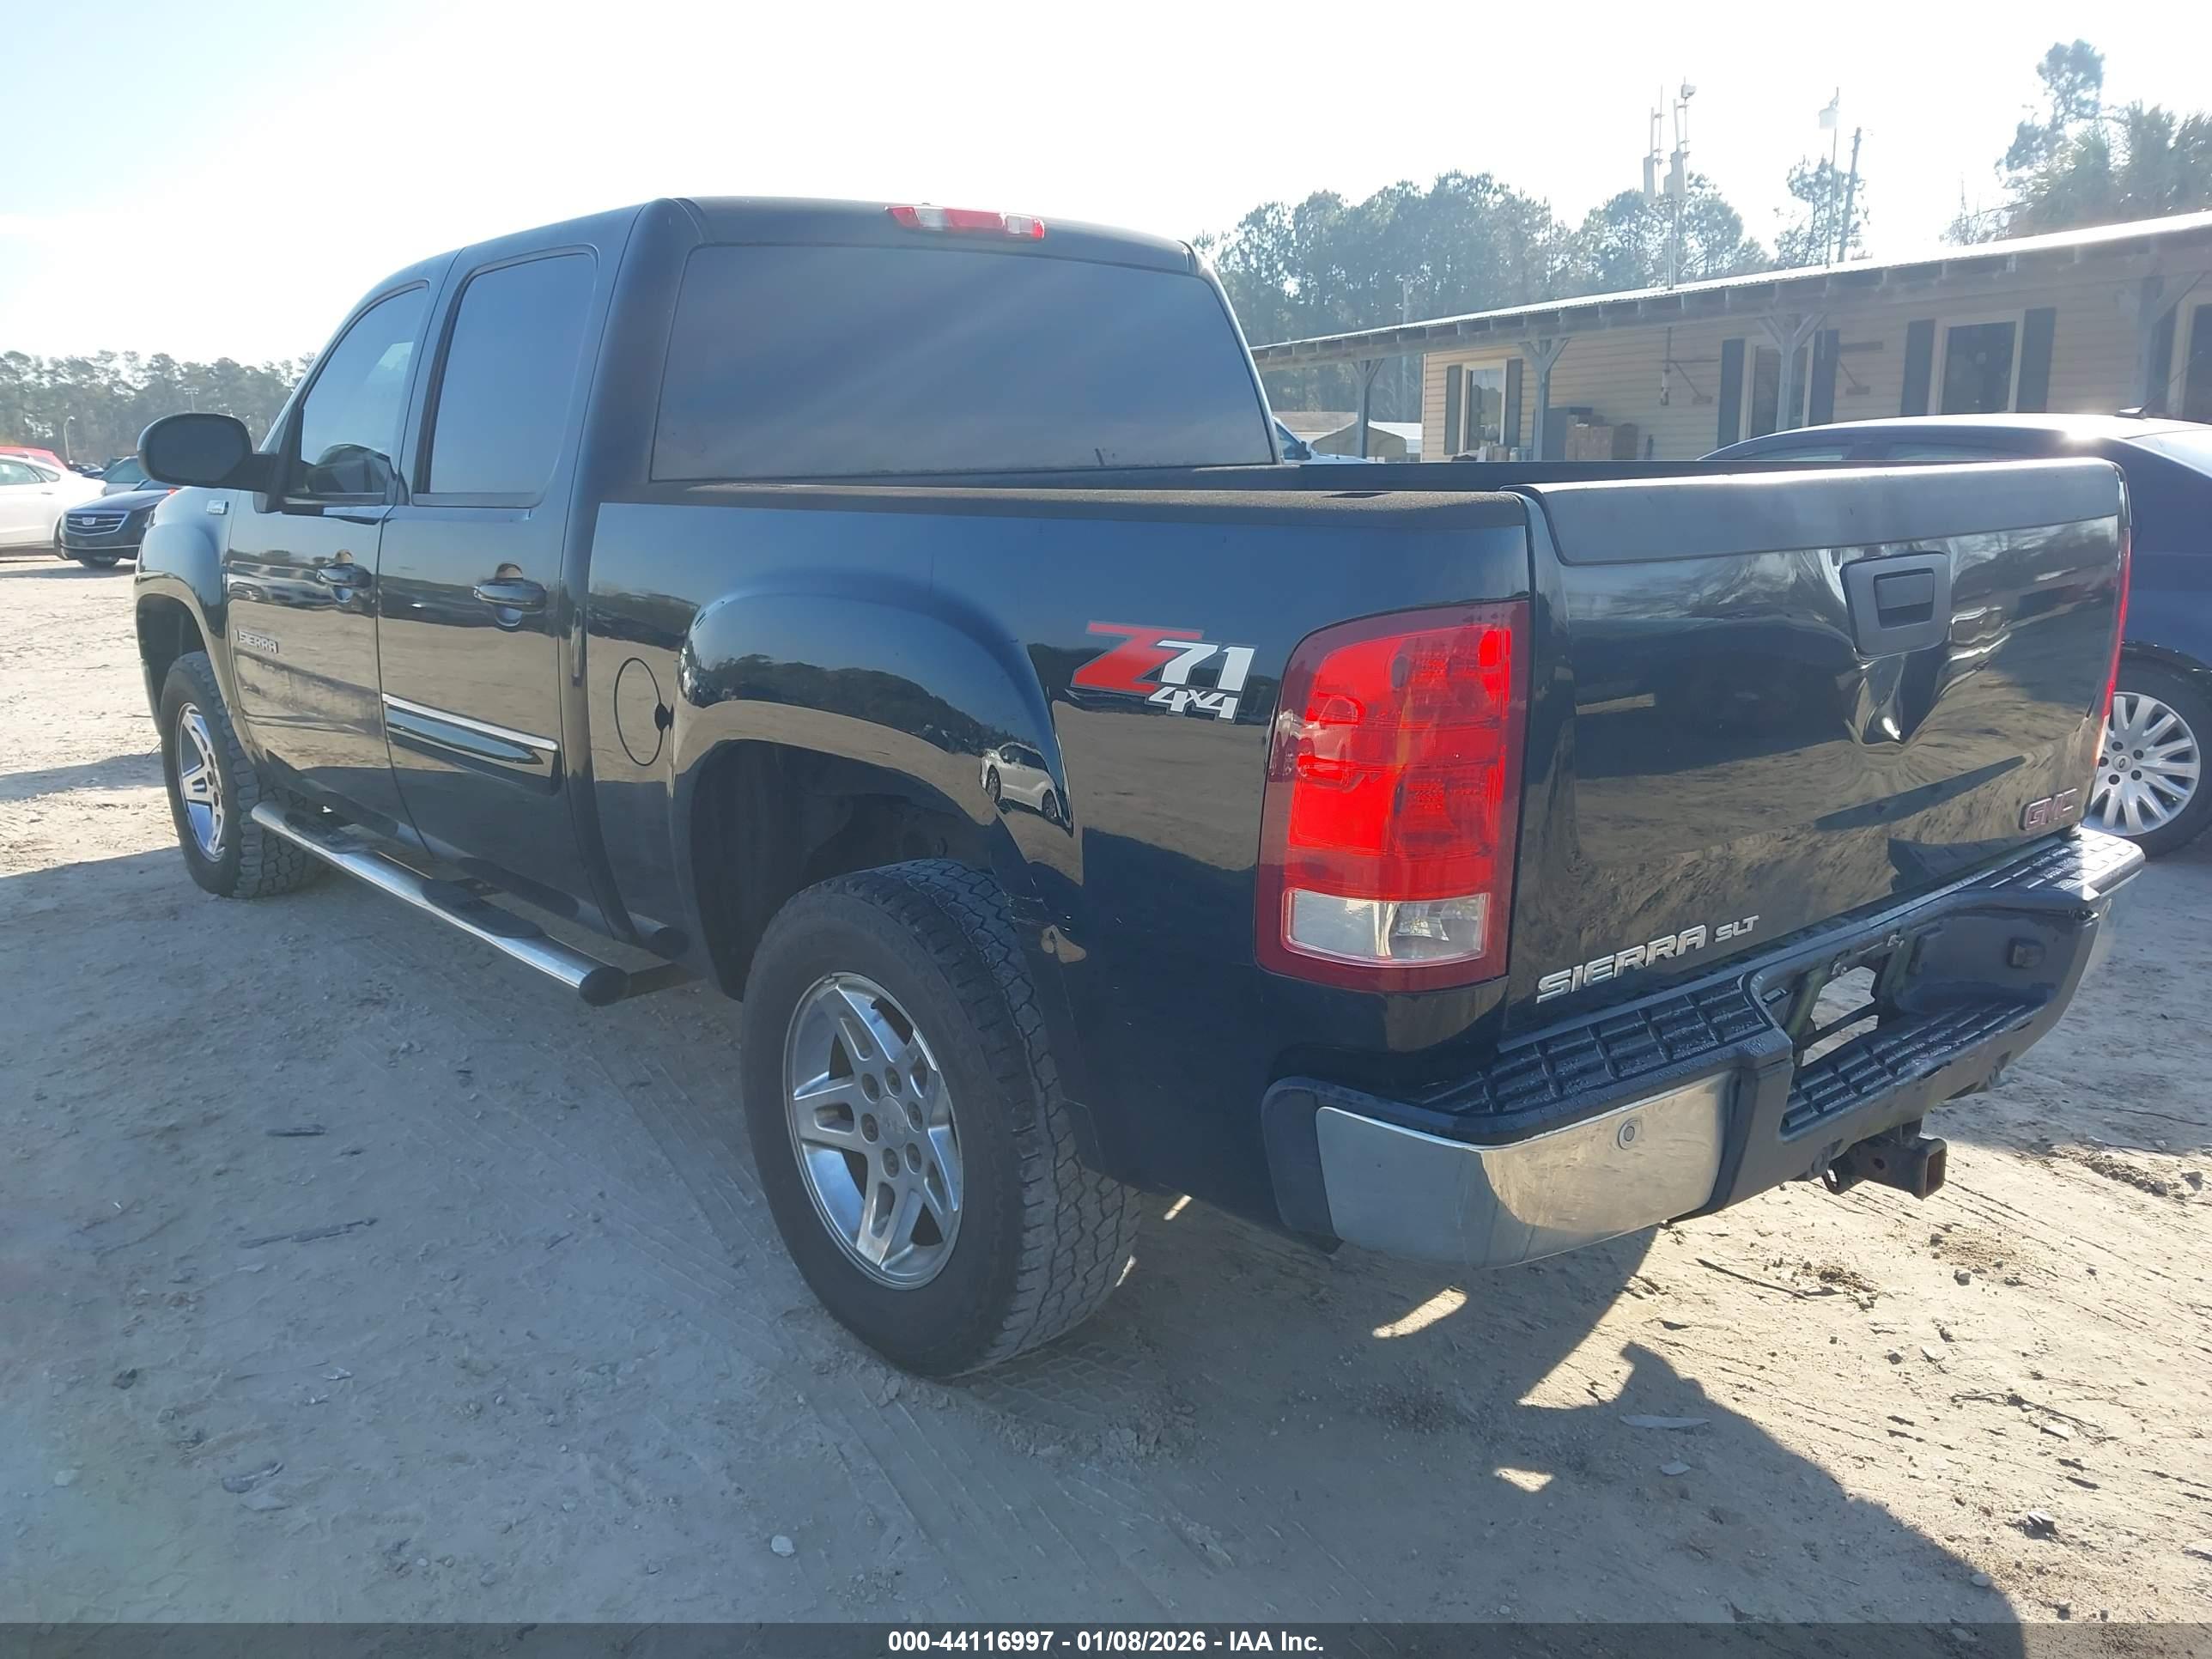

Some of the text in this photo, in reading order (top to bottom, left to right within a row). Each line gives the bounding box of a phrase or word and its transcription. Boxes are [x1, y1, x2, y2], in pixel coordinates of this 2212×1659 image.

[1073, 622, 1256, 694] Z71
[2024, 787, 2078, 830] GMC
[1536, 915, 1759, 1004] SIERRA SLT
